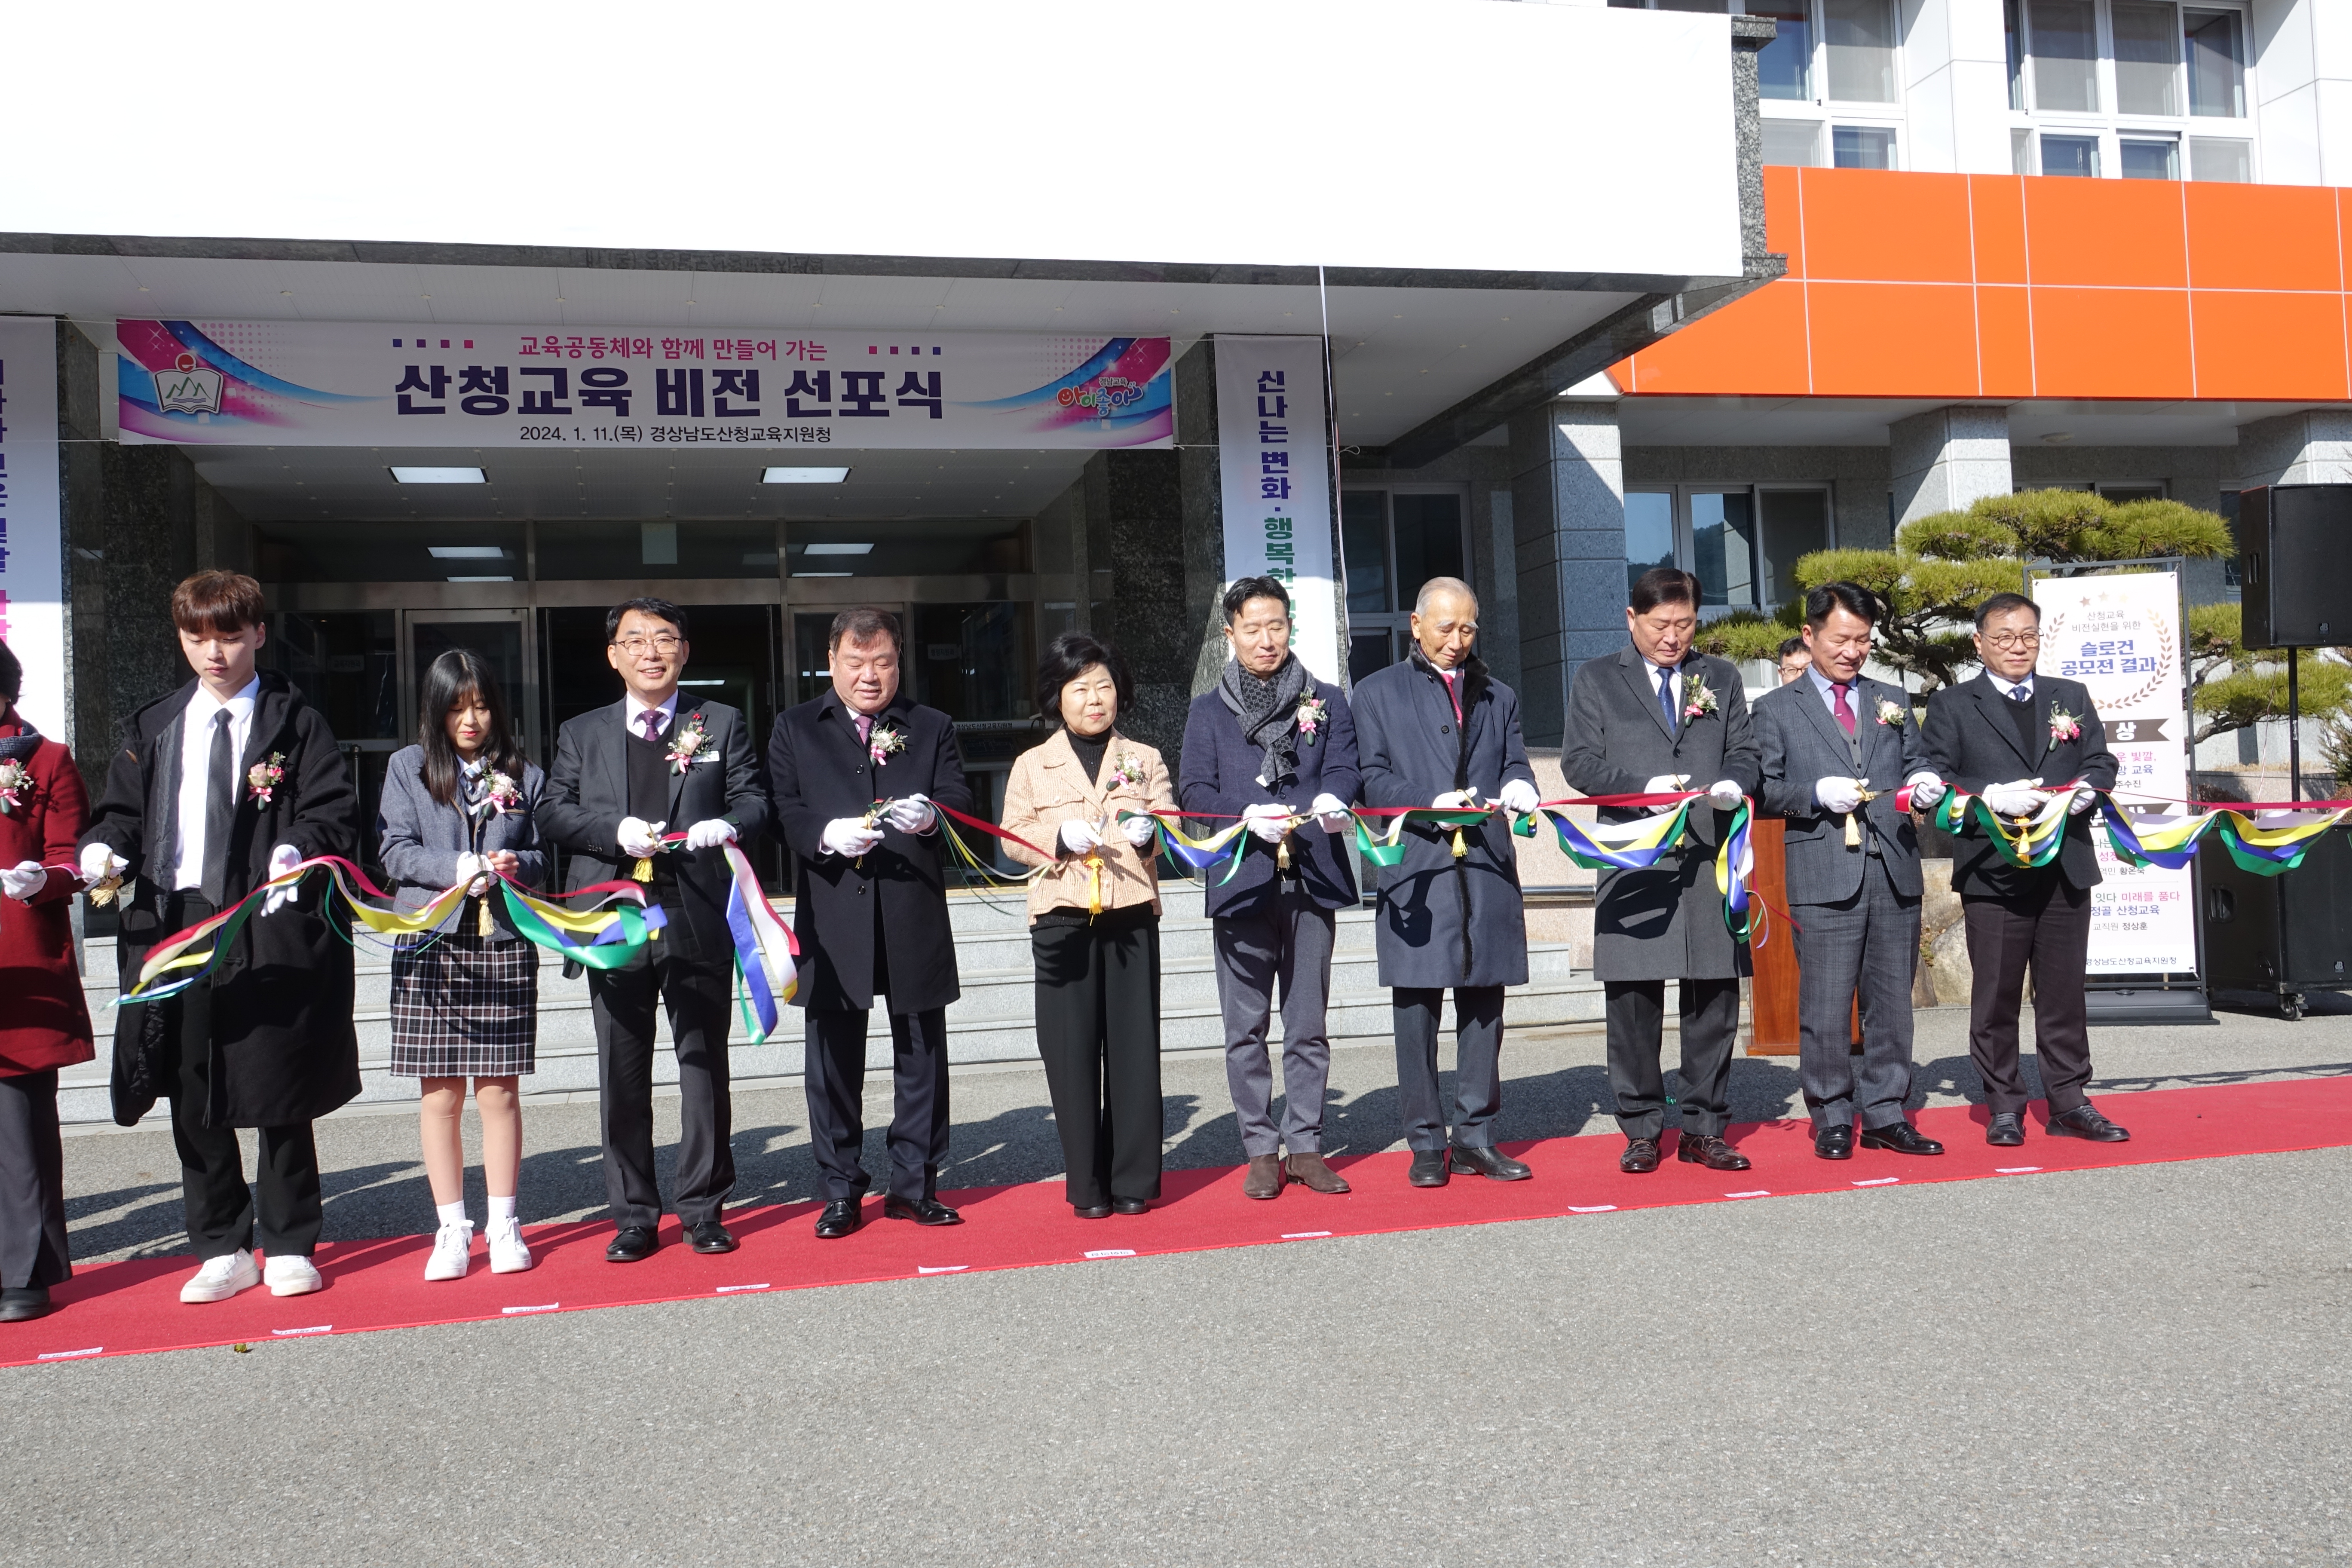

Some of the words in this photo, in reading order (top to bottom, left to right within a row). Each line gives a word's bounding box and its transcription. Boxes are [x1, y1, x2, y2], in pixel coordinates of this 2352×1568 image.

[518, 336, 654, 359] 교육공동체와
[661, 337, 704, 360] 함께
[713, 339, 776, 361] 만들어
[786, 340, 827, 361] 가는
[1099, 377, 1127, 386] 경남교육
[395, 365, 632, 417] 산청교육
[655, 368, 760, 417] 비전
[784, 370, 943, 419] 선포식
[1057, 386, 1143, 416] 아이좋아
[1257, 371, 1289, 443] 신나는
[520, 426, 566, 441] 2024.
[573, 427, 585, 441] 1.
[593, 425, 643, 443] 11.(목)
[650, 426, 831, 443] 경상남도산청교육지원청
[2087, 610, 2124, 621] 산청교육
[2072, 622, 2119, 632] 비전실현을
[2122, 620, 2141, 630] 위한
[2080, 640, 2134, 657] 슬로건
[2061, 658, 2114, 676] 공모전
[2120, 657, 2157, 674] 결과
[2131, 751, 2156, 762] 빛깔,
[2132, 764, 2153, 775] 교육
[2116, 779, 2141, 788] 주수진
[2095, 892, 2116, 903] 잇다
[2122, 891, 2153, 902] 미래를
[2158, 891, 2180, 901] 품다
[2116, 905, 2160, 916] 산청교육
[2093, 922, 2118, 931] 교직원
[2122, 922, 2147, 931] 정상훈
